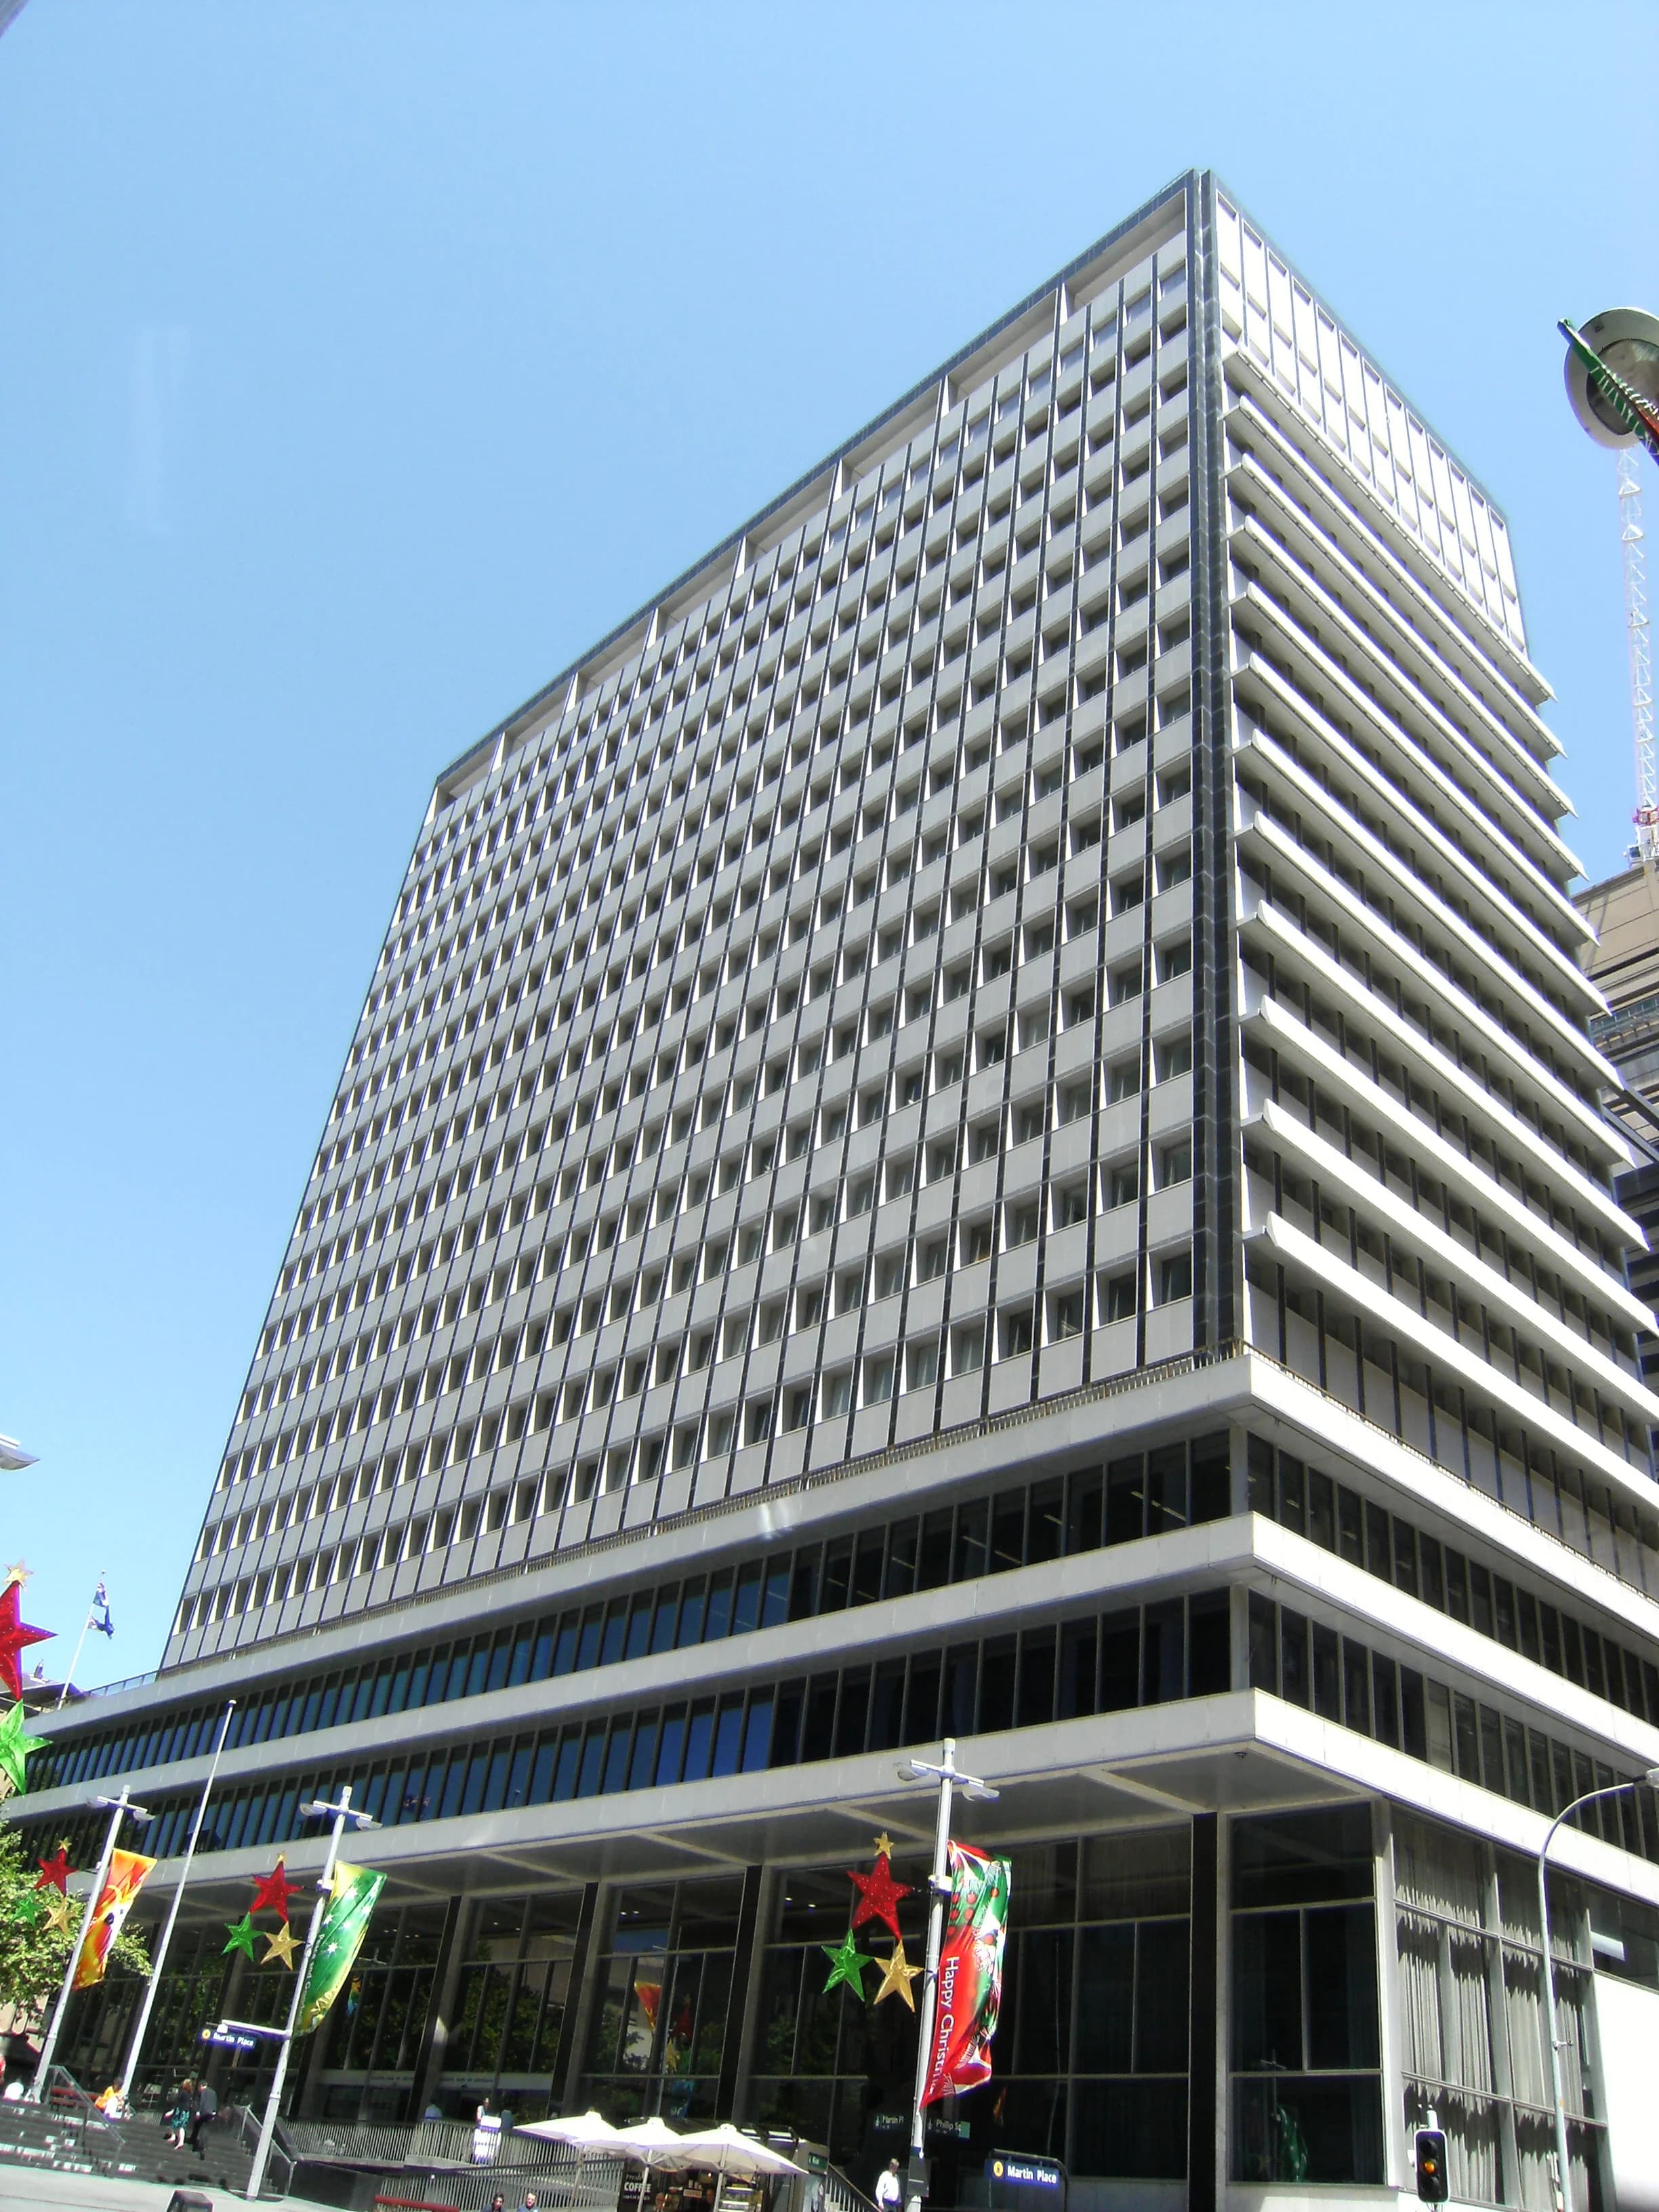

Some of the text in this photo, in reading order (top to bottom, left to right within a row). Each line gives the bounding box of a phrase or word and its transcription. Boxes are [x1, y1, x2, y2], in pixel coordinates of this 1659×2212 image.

[929, 1956, 960, 2095] Happy Christma
[237, 2036, 254, 2047] Place
[1007, 2165, 1057, 2184] Martin Place
[623, 2182, 651, 2193] COFFE
